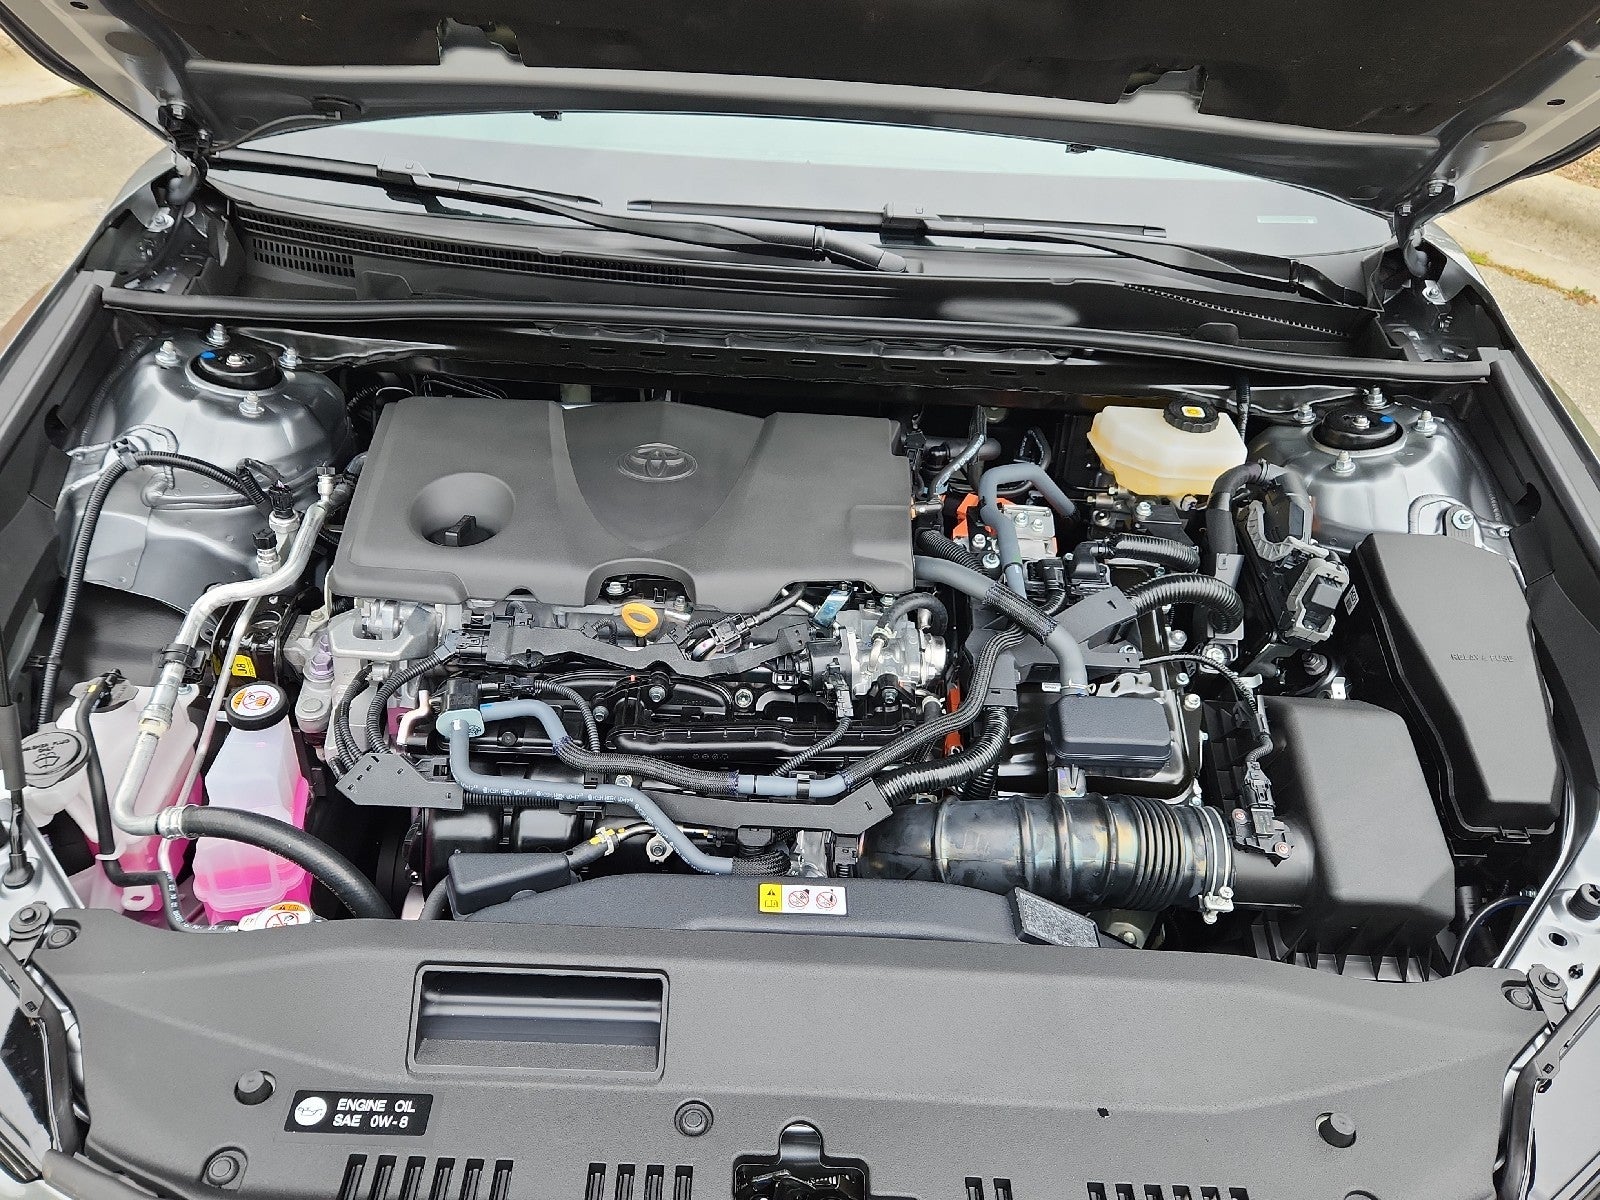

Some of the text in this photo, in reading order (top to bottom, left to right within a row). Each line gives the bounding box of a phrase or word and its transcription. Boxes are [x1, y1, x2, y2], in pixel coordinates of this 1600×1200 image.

[1489, 655, 1514, 663] FUSE
[336, 1098, 416, 1113] ENGINE OIL
[332, 1113, 409, 1129] SAE 0W-8
